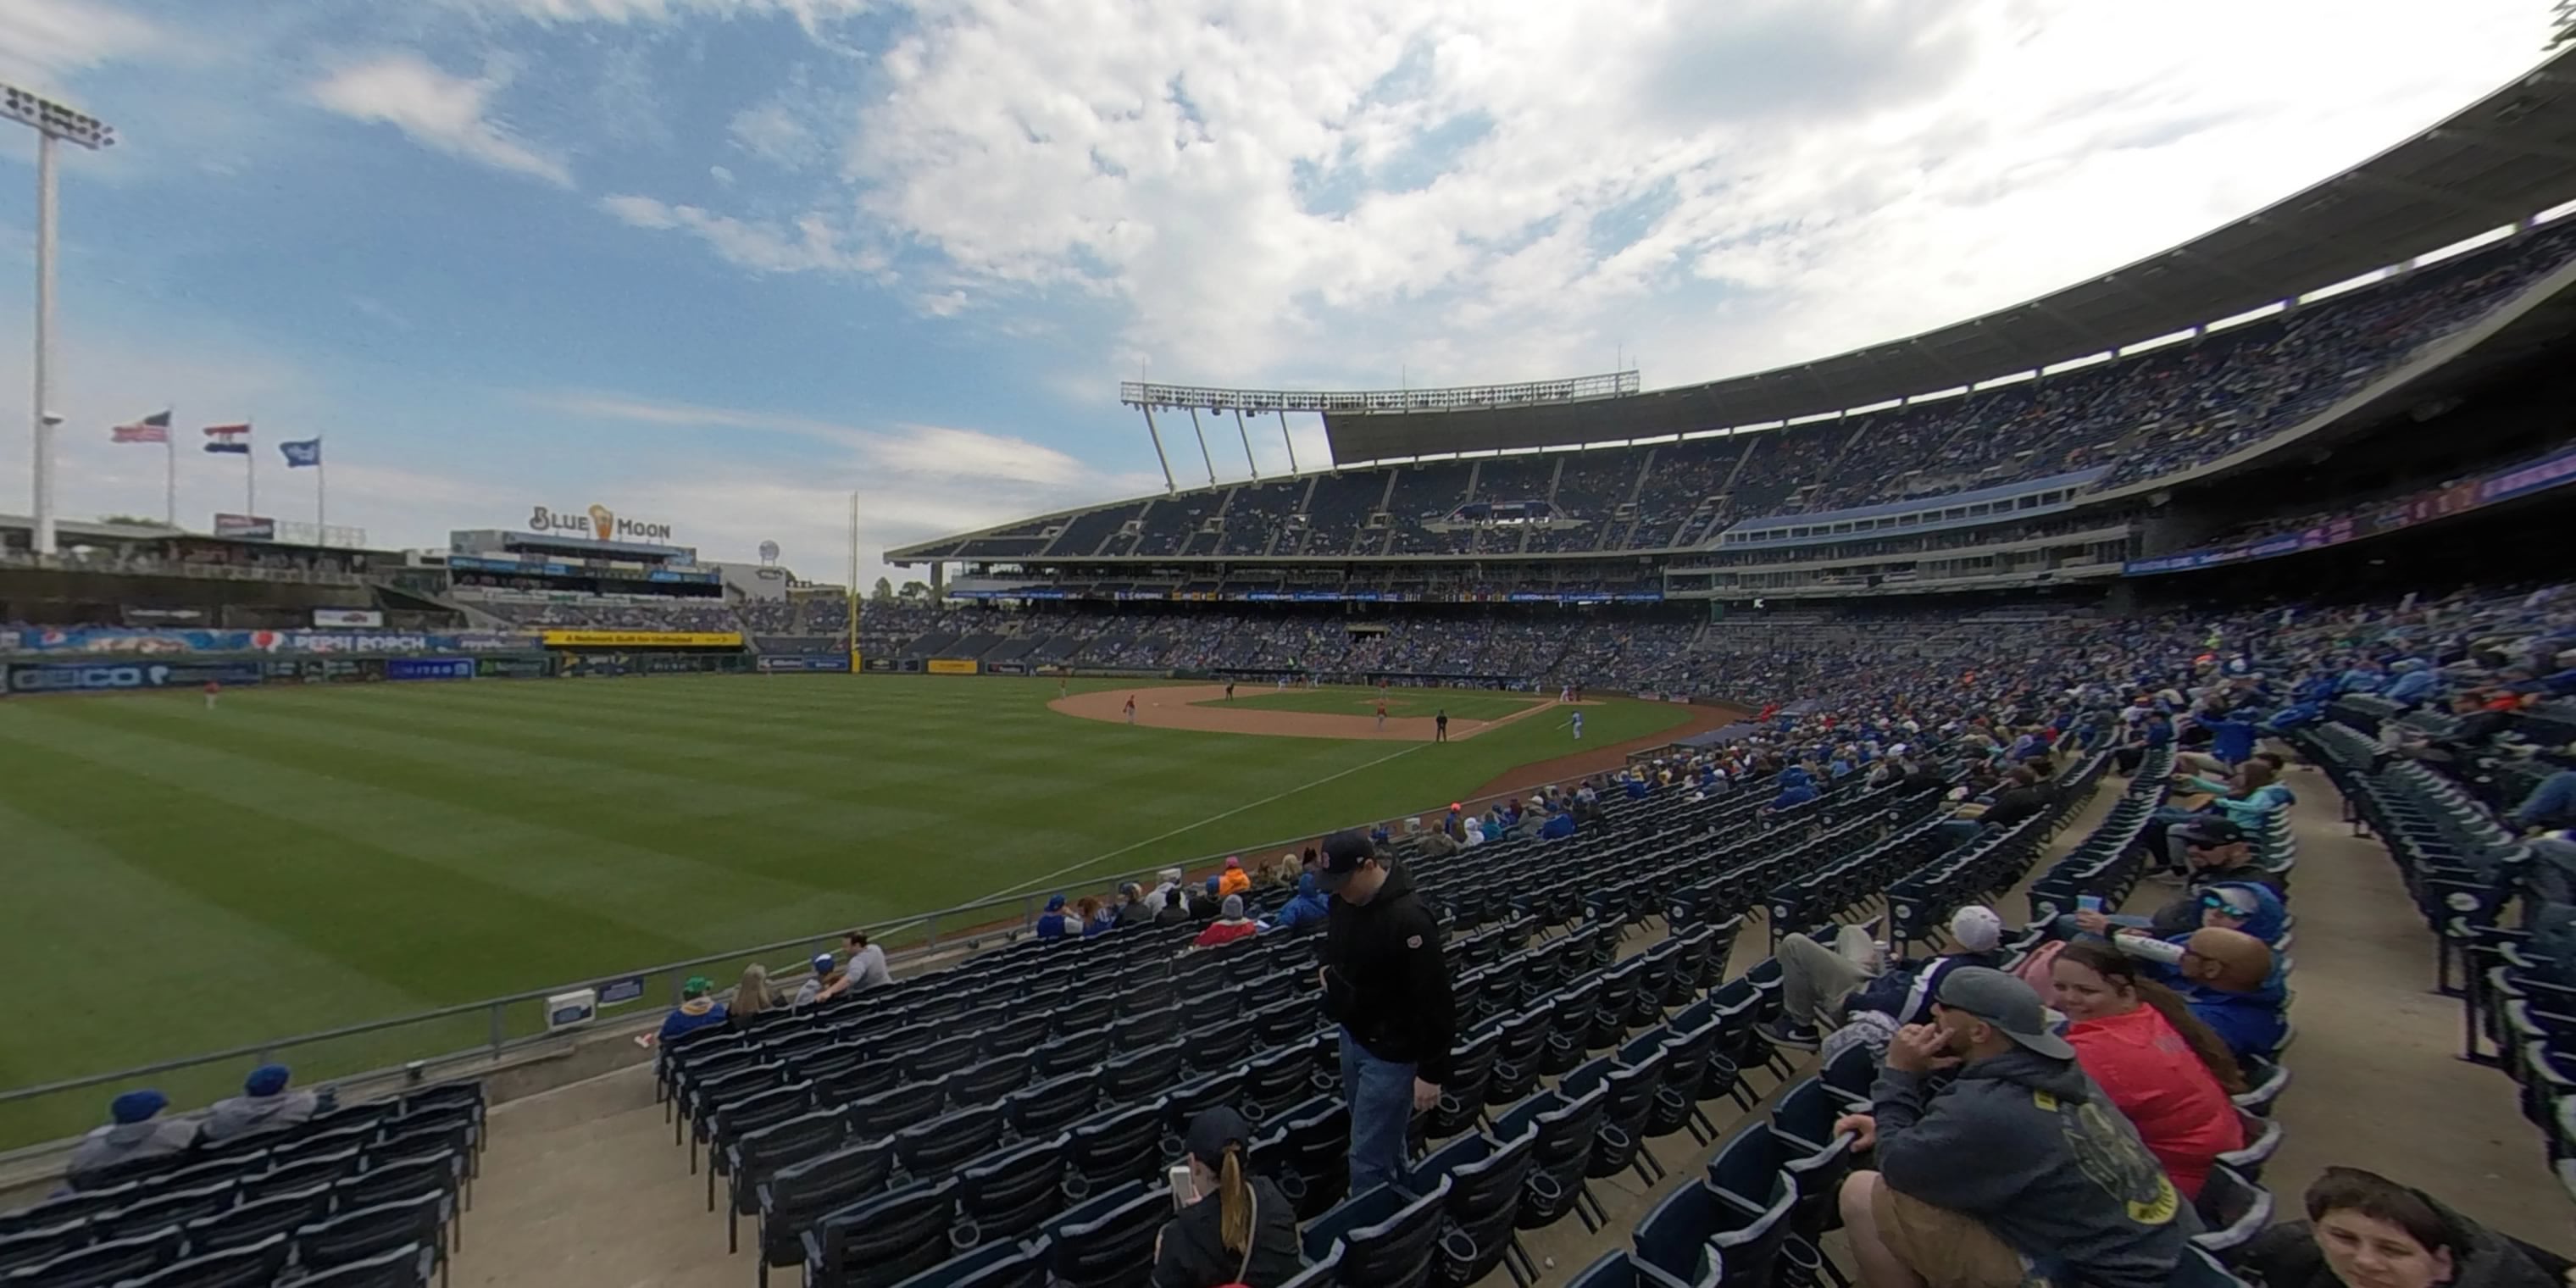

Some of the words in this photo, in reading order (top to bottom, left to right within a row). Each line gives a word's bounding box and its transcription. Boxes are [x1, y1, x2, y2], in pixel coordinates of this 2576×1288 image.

[294, 636, 353, 652] PEPSI
[357, 636, 425, 652] PORCH
[13, 667, 142, 689] GEICO
